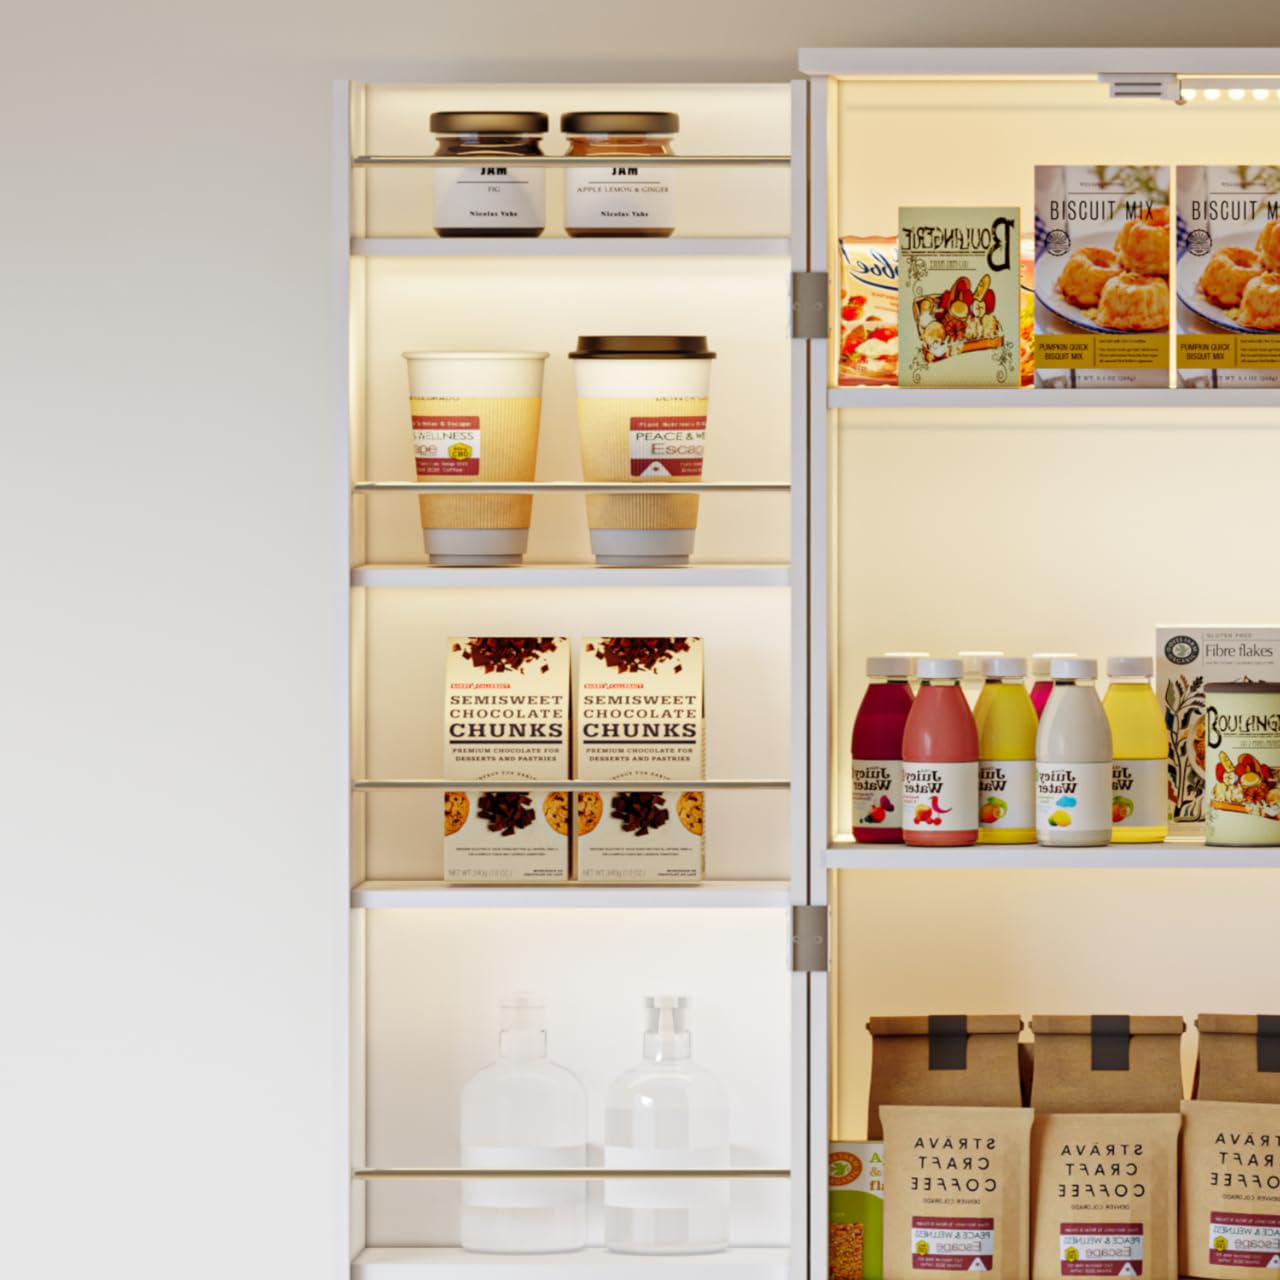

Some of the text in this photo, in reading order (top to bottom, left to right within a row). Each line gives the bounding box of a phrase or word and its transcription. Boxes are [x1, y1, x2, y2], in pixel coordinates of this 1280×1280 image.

[1050, 200, 1154, 220] BISCUIT MIX
[1192, 200, 1257, 220] BISCUIT
[1071, 352, 1083, 360] MIX
[636, 432, 694, 441] PEACE &
[1205, 643, 1236, 657] Fibre
[1238, 643, 1273, 657] flakes
[450, 696, 563, 705] SEMISWEET
[583, 696, 696, 705] SEMISWEET
[450, 709, 563, 719] CHOCOLATE
[583, 709, 696, 719] CHOCOLATE
[449, 723, 563, 738] CHUNKS
[583, 723, 697, 738] CHUNKS
